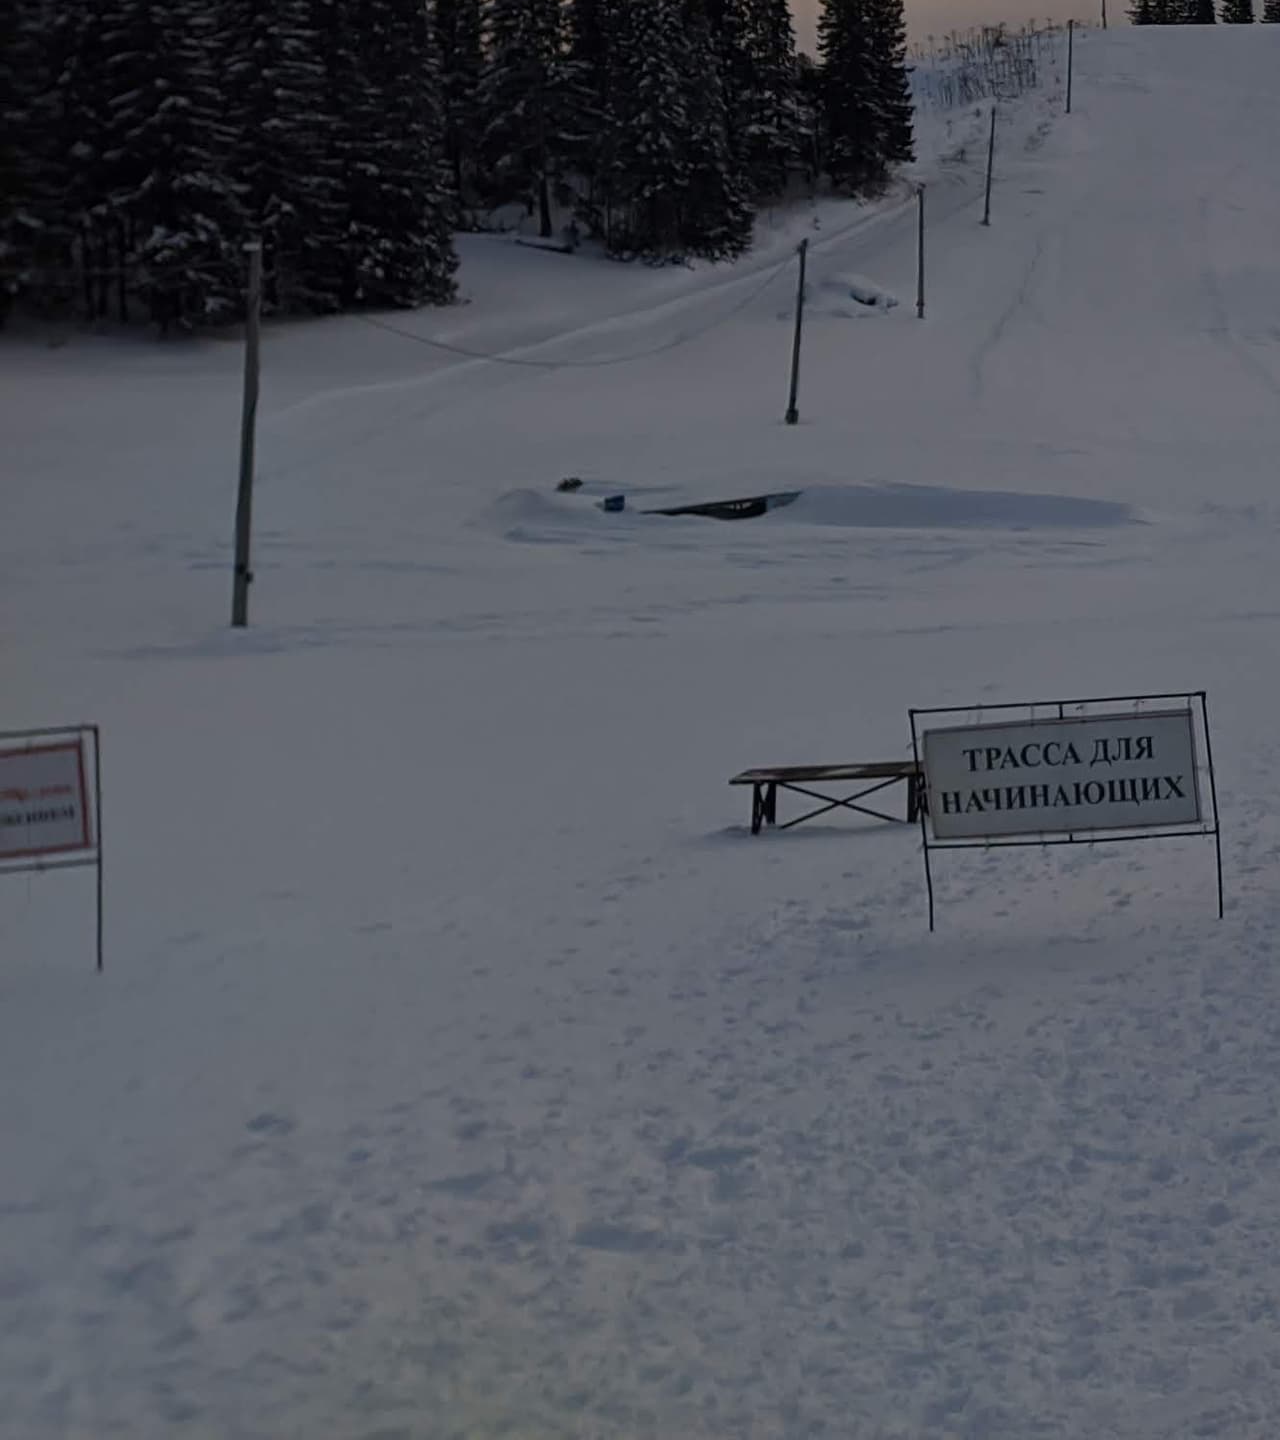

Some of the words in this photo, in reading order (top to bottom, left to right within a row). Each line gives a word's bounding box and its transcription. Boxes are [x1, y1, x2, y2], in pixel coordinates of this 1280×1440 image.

[962, 742, 1081, 772] ТРАССА
[1089, 735, 1155, 768] ДЛЯ
[940, 775, 1187, 814] НАЧИНАЮЩИХ
